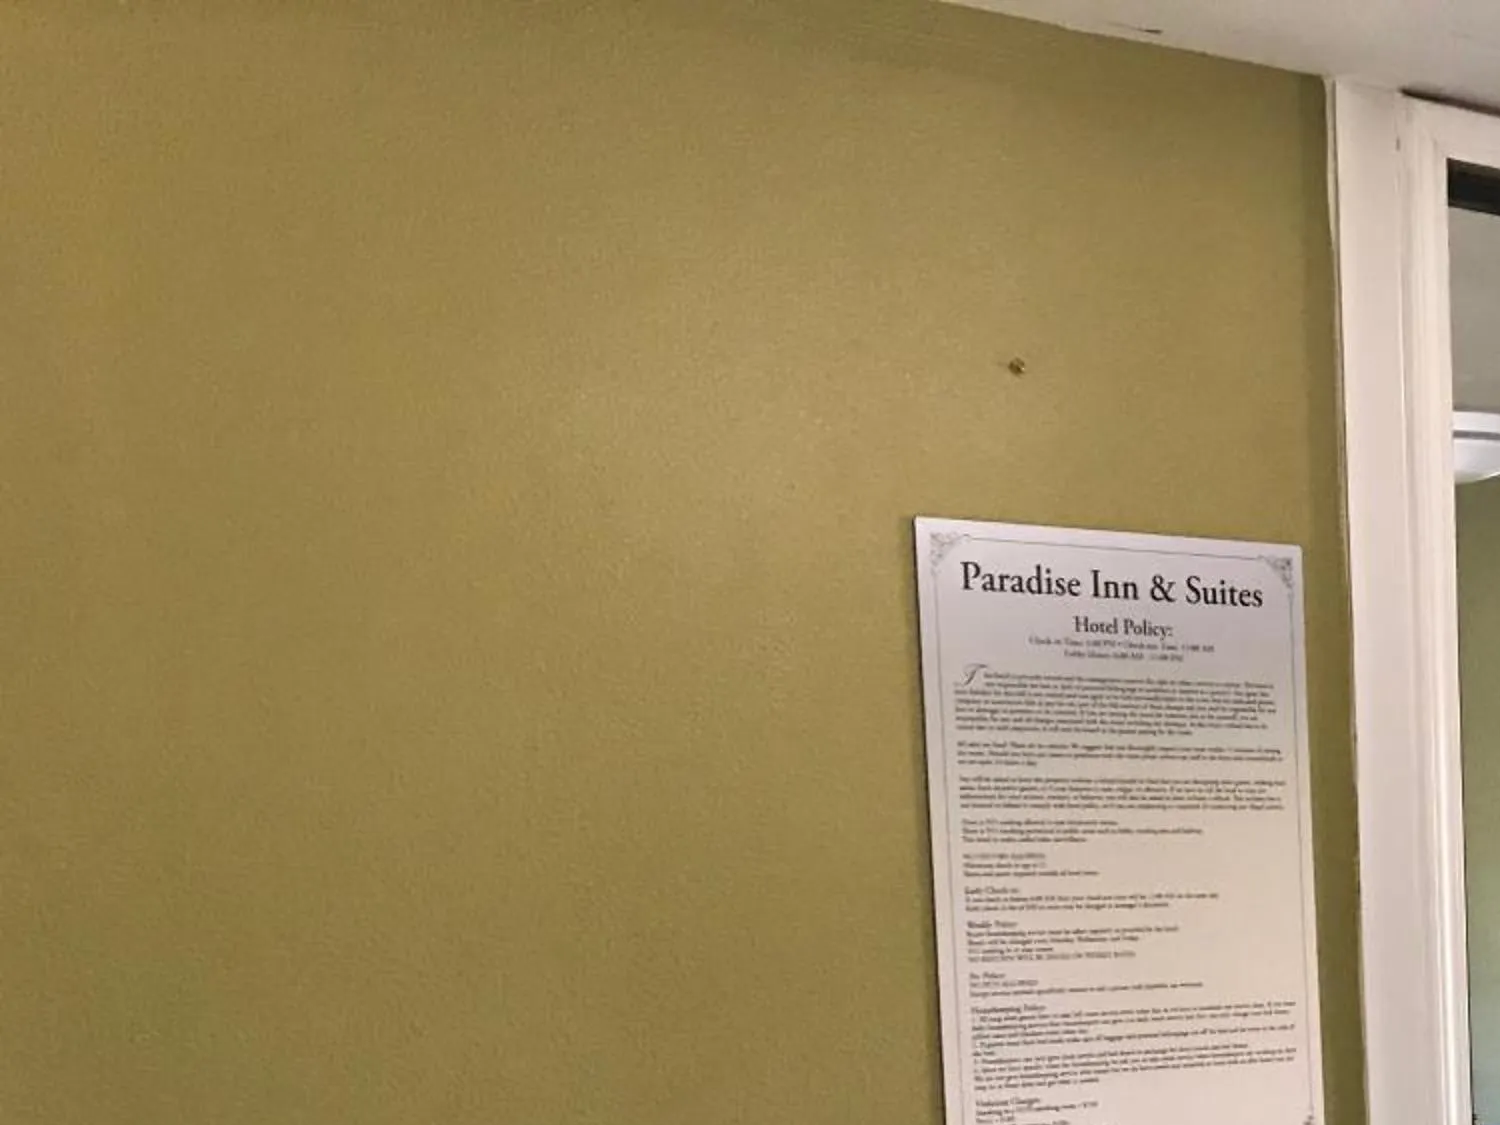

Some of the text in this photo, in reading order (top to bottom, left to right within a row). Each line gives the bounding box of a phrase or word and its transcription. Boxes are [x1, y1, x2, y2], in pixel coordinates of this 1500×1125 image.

[960, 561, 1264, 607] Paradise Inn & Suites
[1073, 615, 1174, 641] Hotel Policy:
